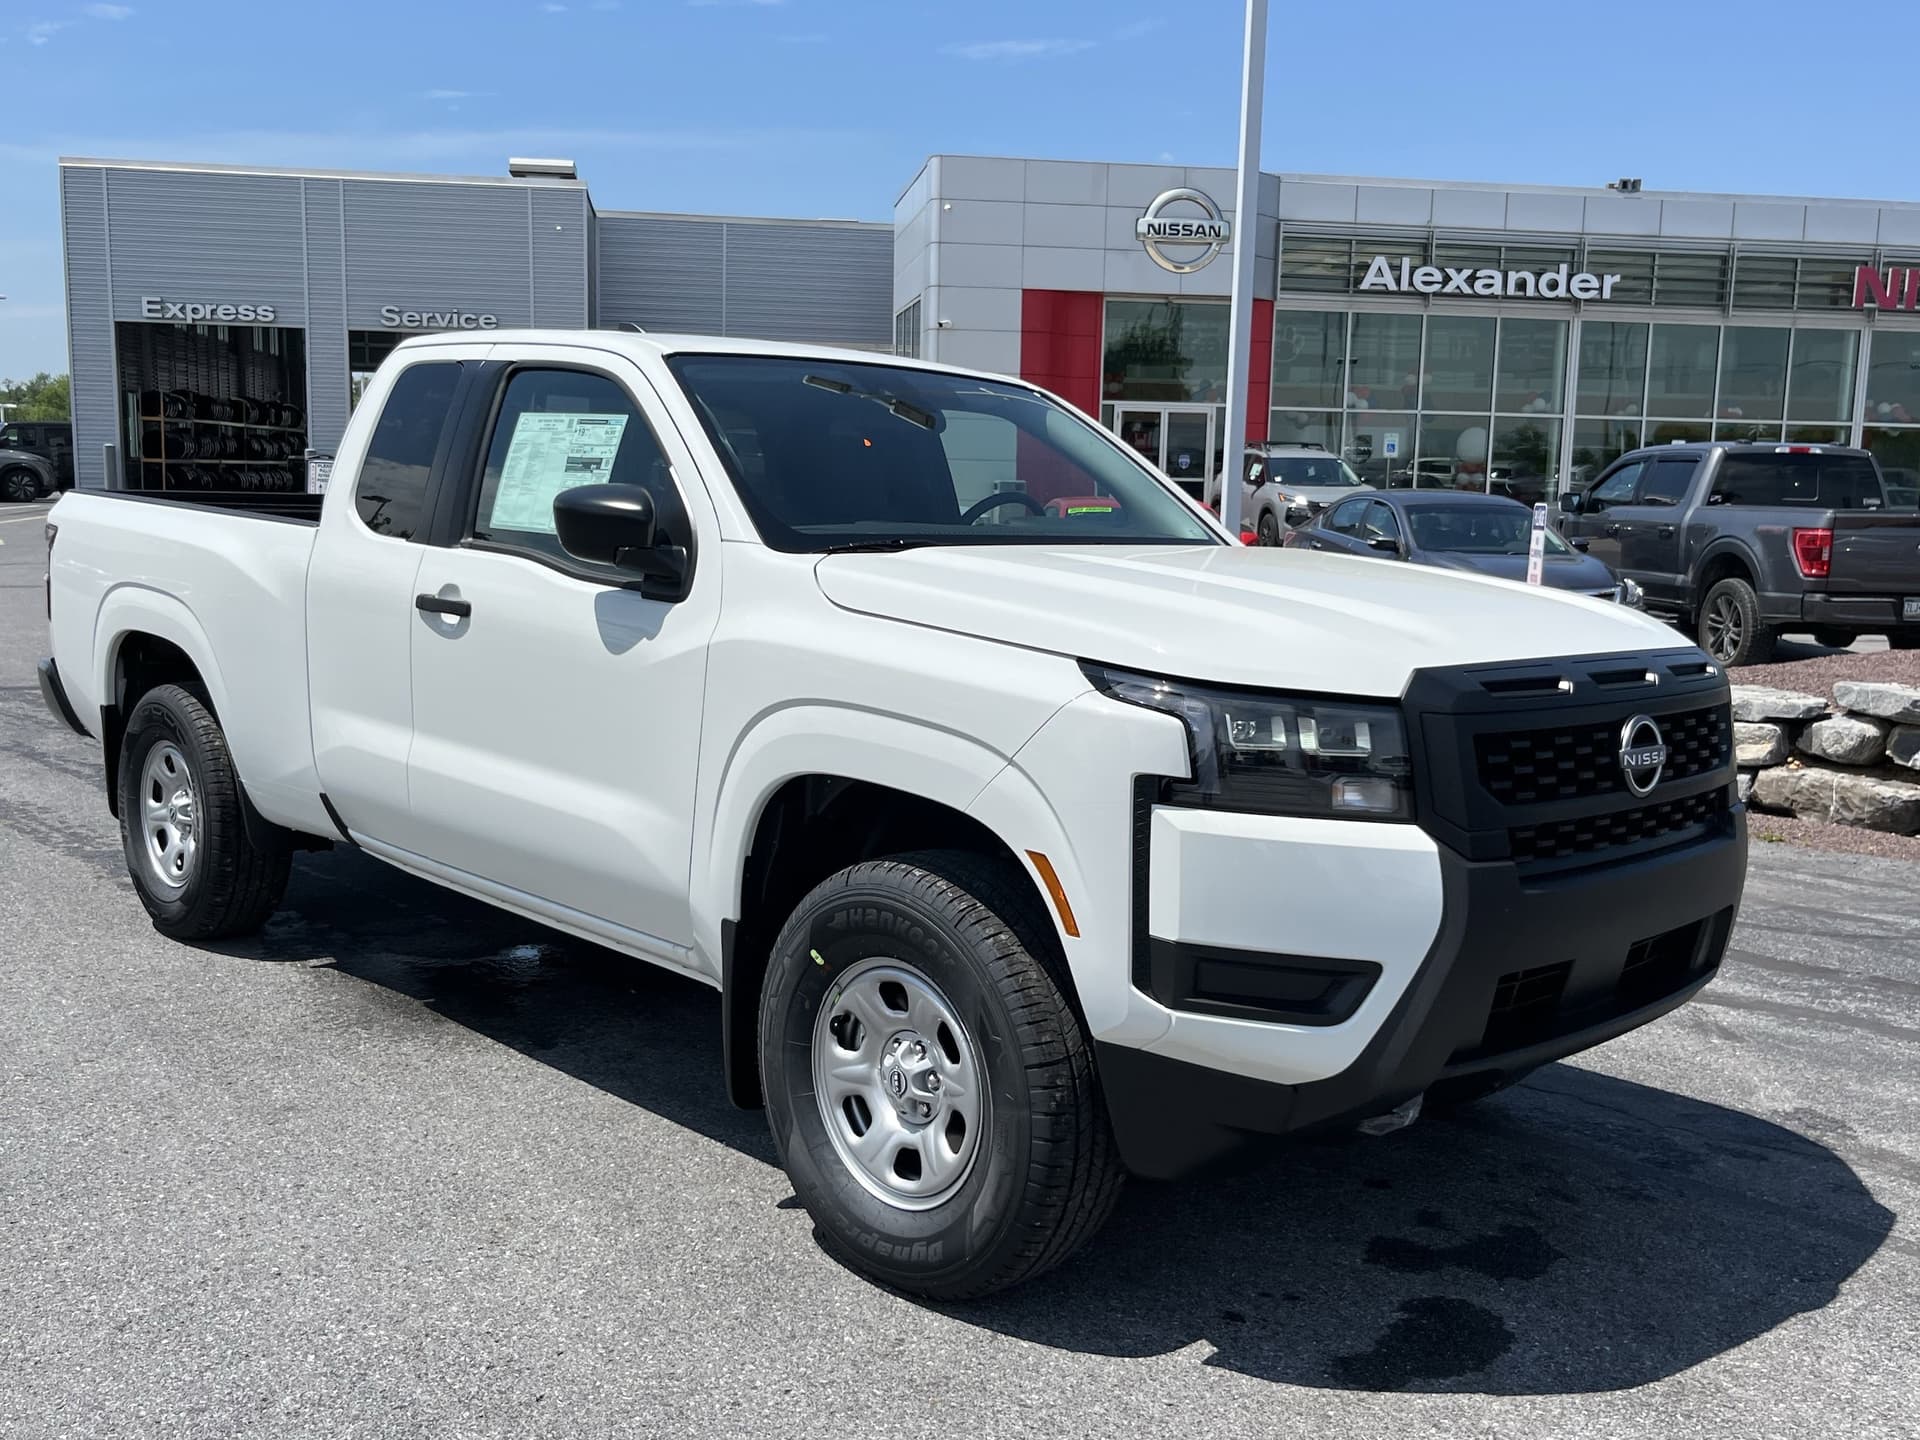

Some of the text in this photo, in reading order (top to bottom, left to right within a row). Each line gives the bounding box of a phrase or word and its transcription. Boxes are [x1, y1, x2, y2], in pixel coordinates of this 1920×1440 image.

[1147, 223, 1221, 237] NISSAN
[1359, 256, 1621, 299] Alexander
[141, 296, 498, 329] Express Service
